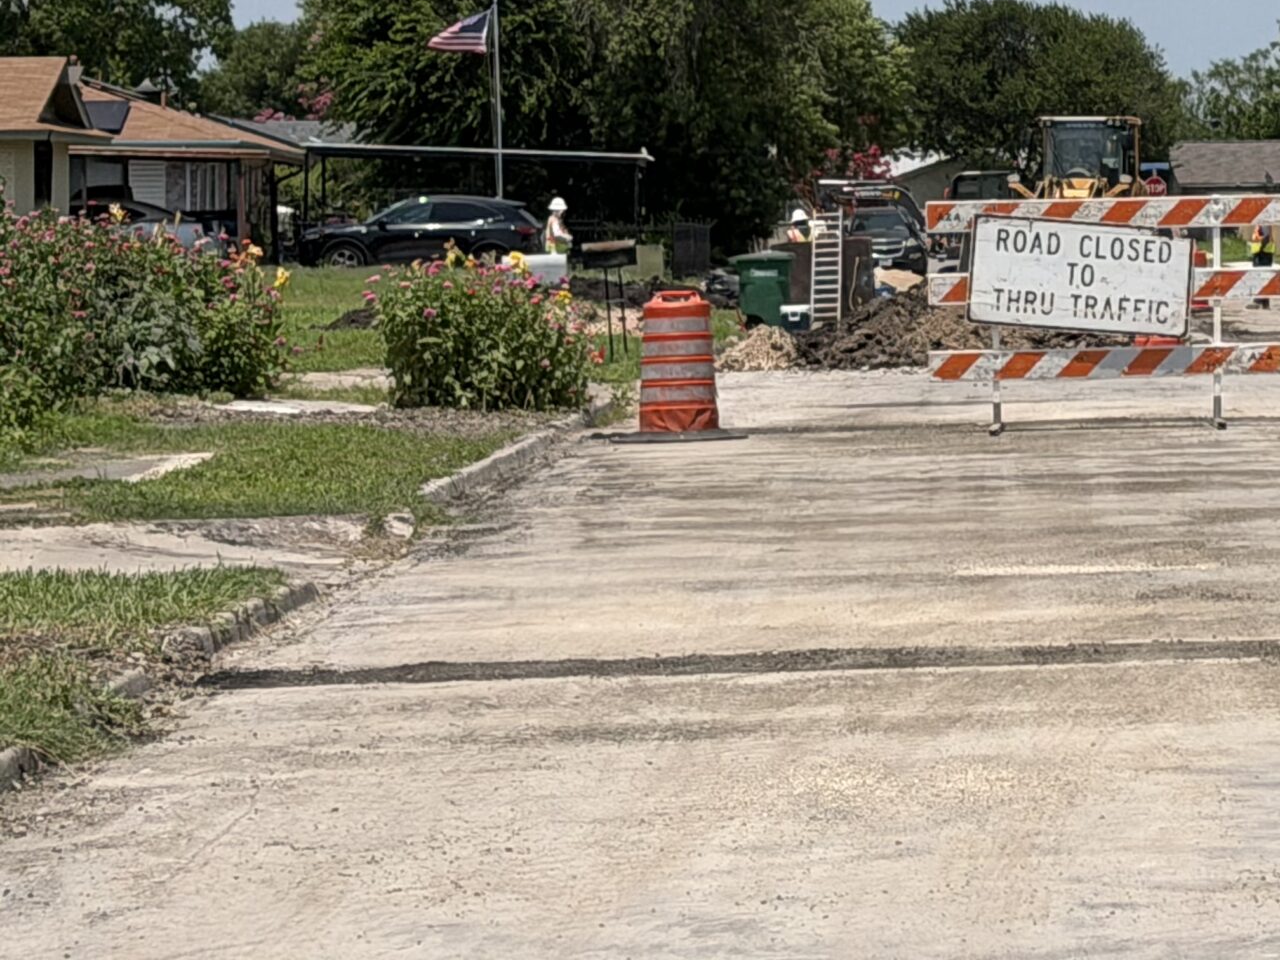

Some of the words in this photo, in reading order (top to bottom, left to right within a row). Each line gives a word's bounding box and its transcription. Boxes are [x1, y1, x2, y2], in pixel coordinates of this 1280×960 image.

[996, 228, 1061, 255] ROAD
[1079, 235, 1172, 264] CLOSED
[1067, 262, 1095, 287] TO
[992, 287, 1055, 315] THRU
[1070, 293, 1169, 324] TRAFFIC
